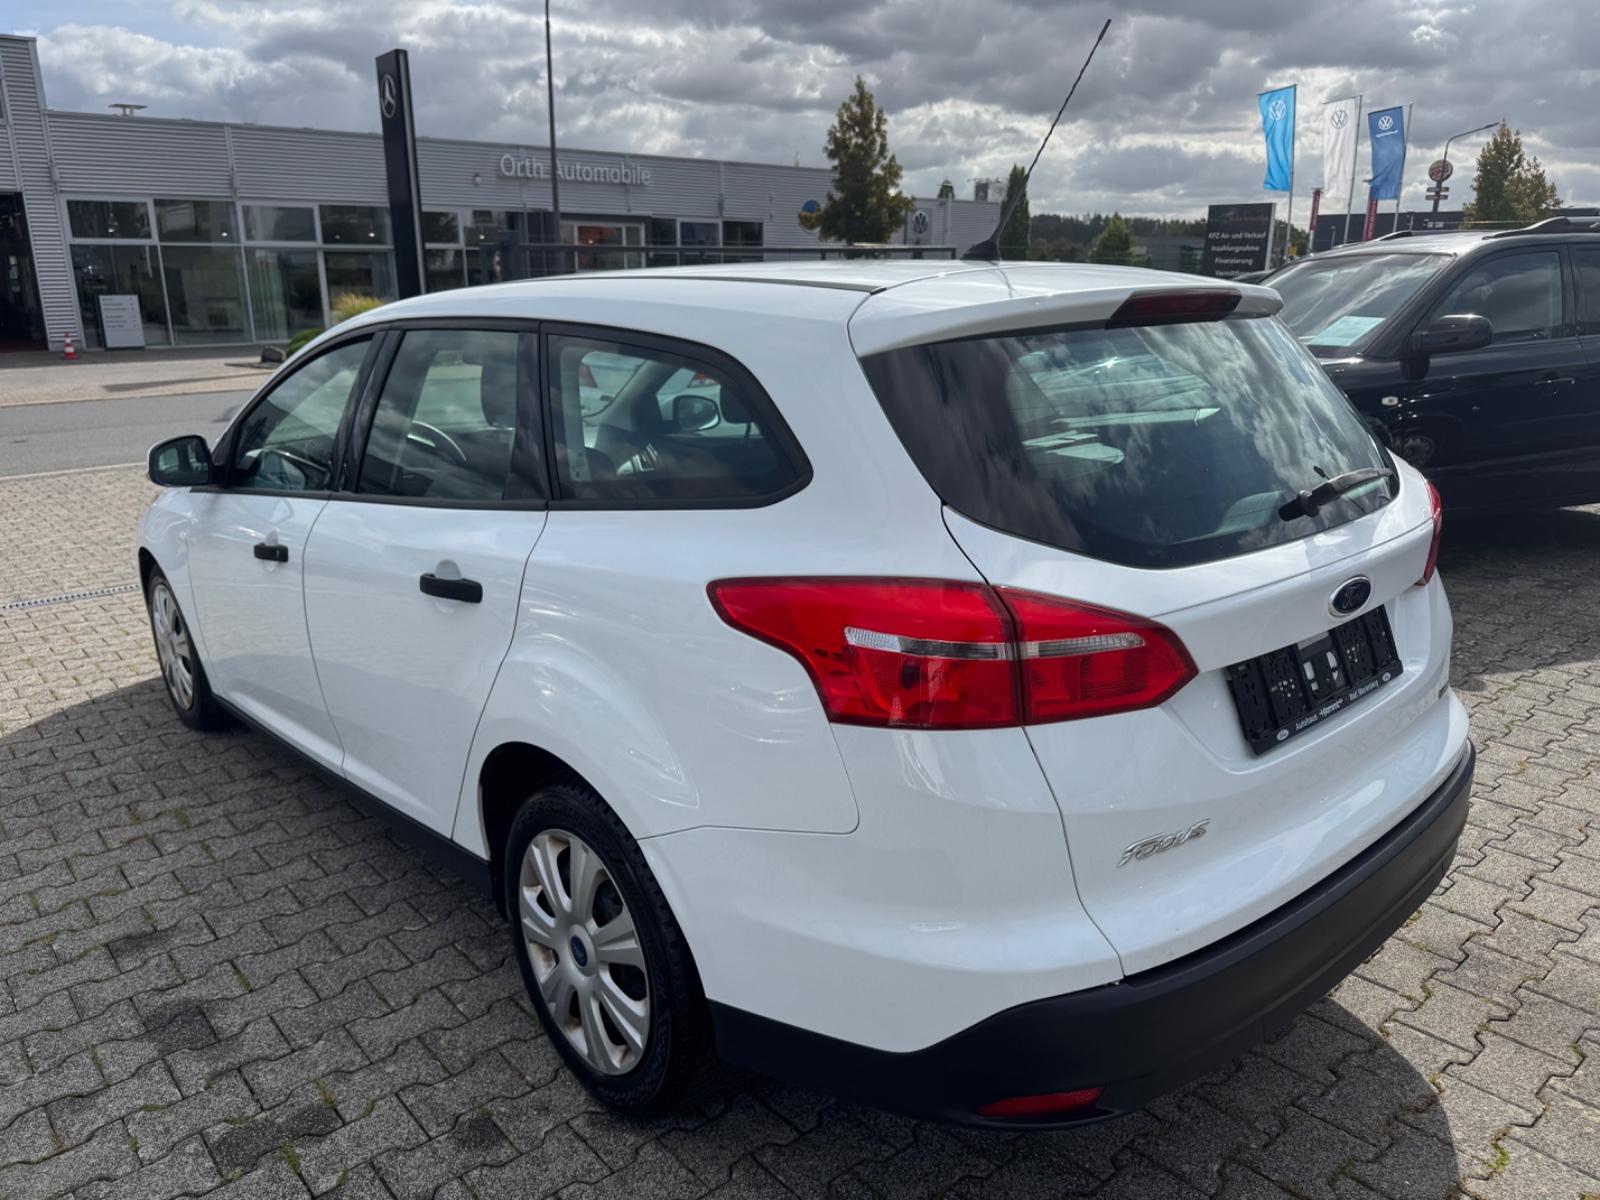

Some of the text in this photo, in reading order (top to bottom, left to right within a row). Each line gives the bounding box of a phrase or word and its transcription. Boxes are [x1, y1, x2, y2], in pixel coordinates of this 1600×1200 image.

[500, 154, 651, 185] Orth Automobile
[1243, 231, 1266, 239] Verkauf
